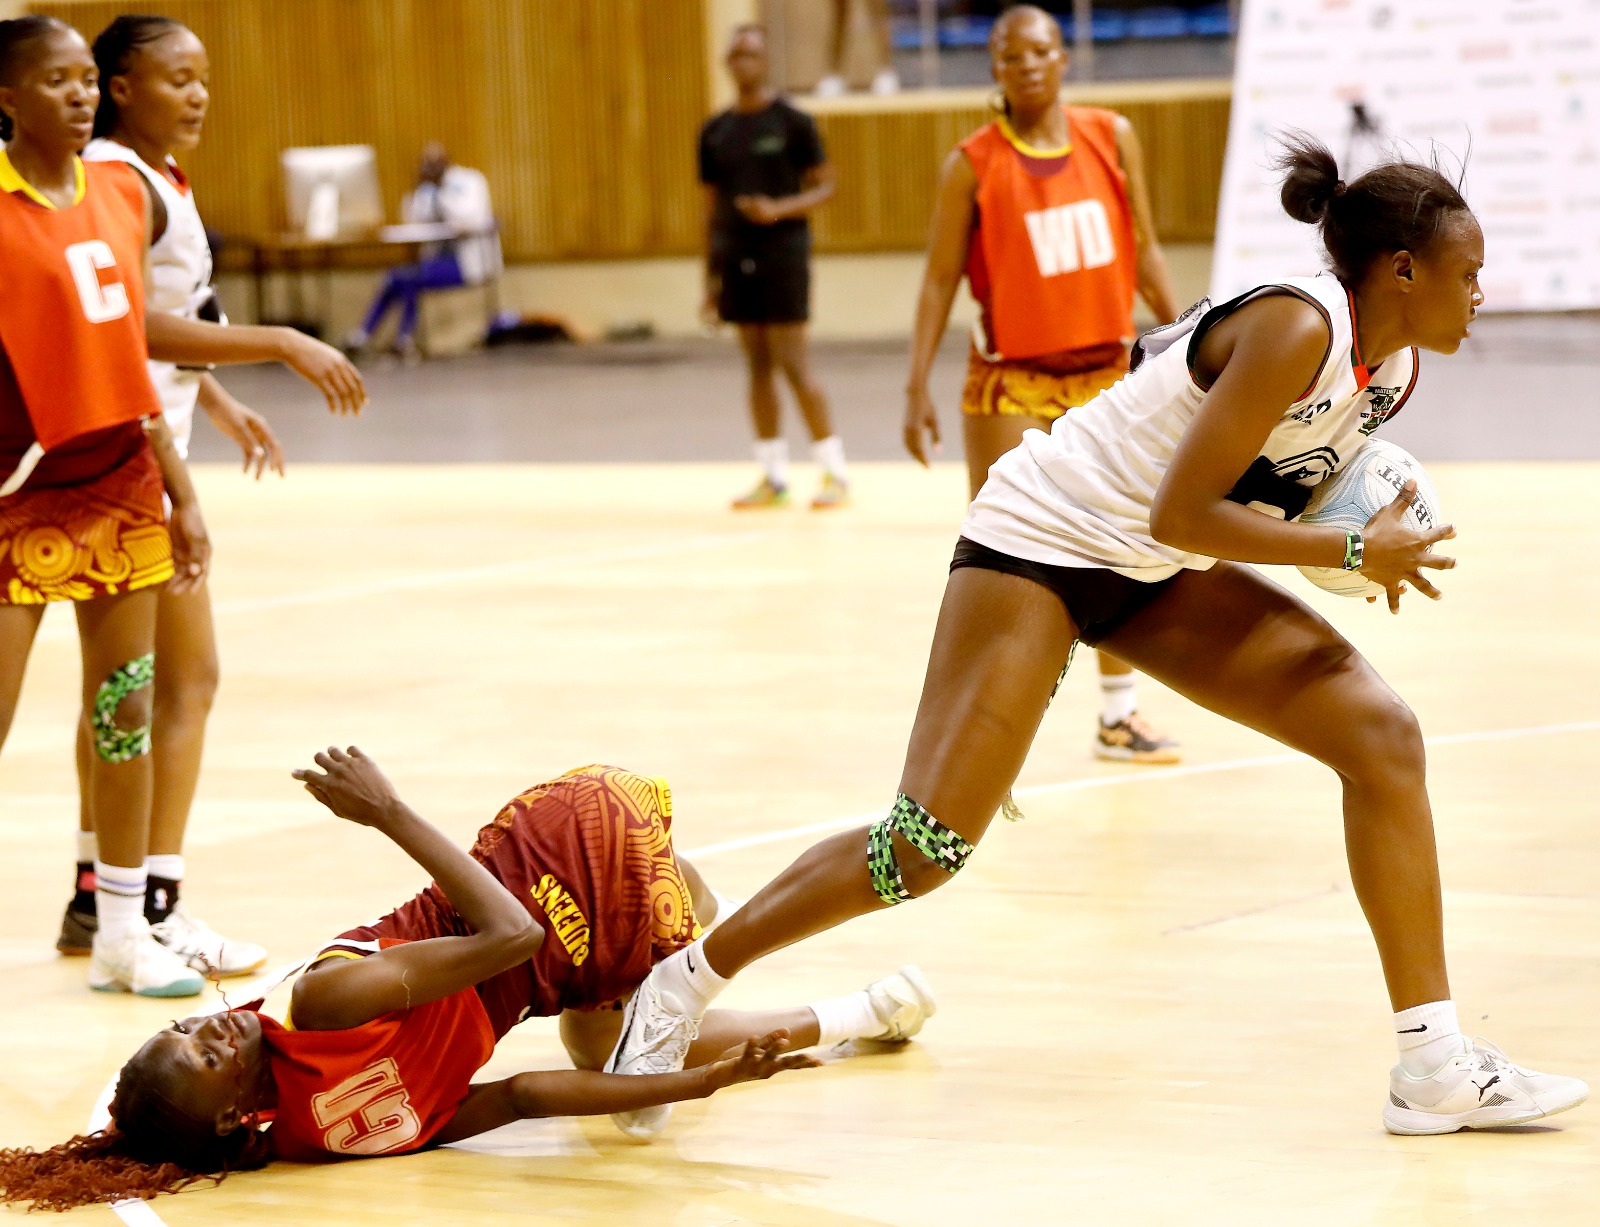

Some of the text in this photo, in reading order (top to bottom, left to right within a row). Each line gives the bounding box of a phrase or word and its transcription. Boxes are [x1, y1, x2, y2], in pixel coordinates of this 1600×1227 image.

[64, 239, 130, 324] C
[1023, 198, 1117, 278] WD
[530, 873, 590, 966] QUEENS
[311, 1057, 421, 1155] GD
